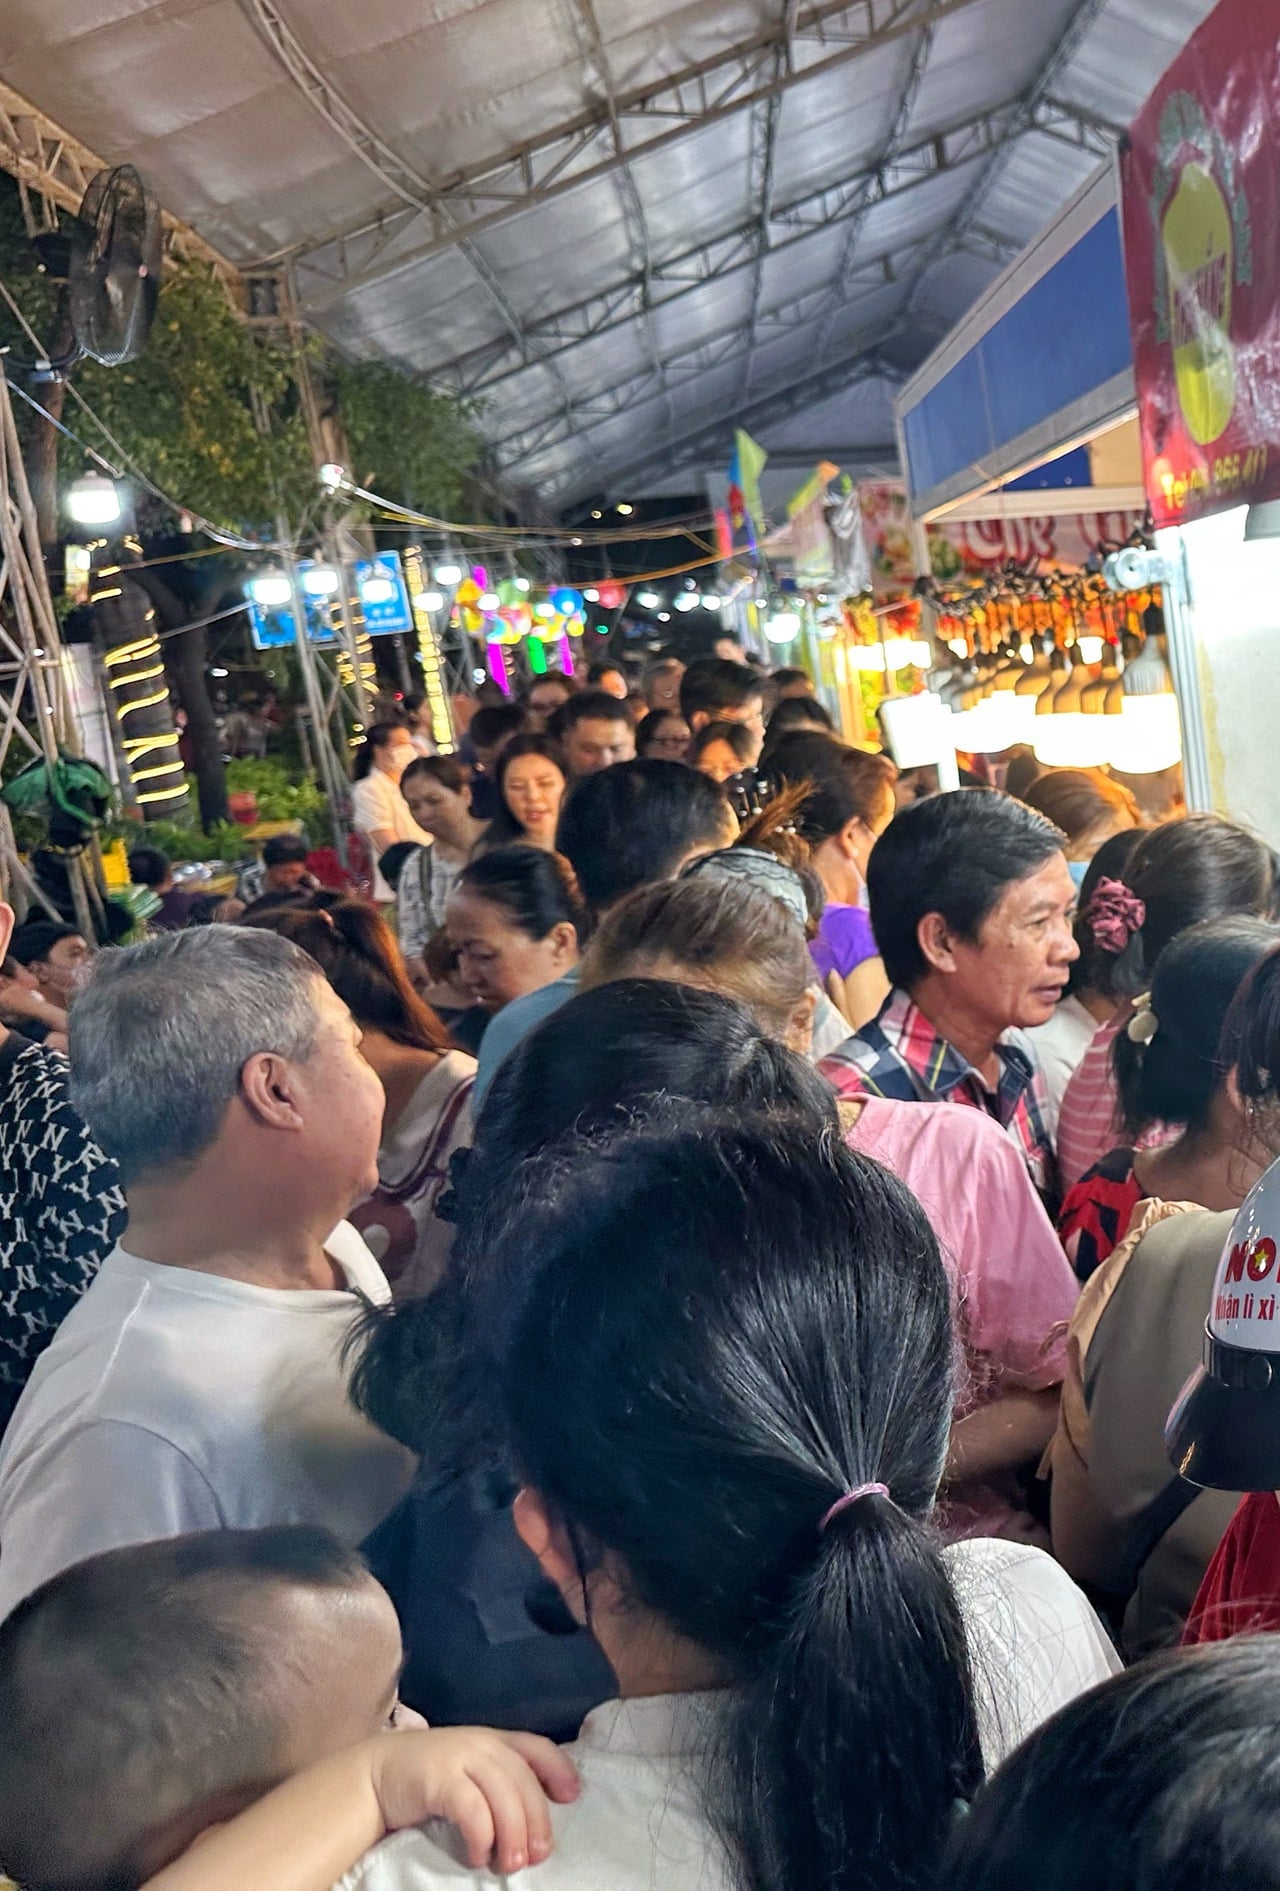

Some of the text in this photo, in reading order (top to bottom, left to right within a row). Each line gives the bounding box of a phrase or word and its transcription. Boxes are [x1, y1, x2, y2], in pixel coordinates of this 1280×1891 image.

[1215, 1293, 1240, 1325] Nhận
[1243, 1293, 1254, 1319] lì
[1257, 1294, 1275, 1321] xì
